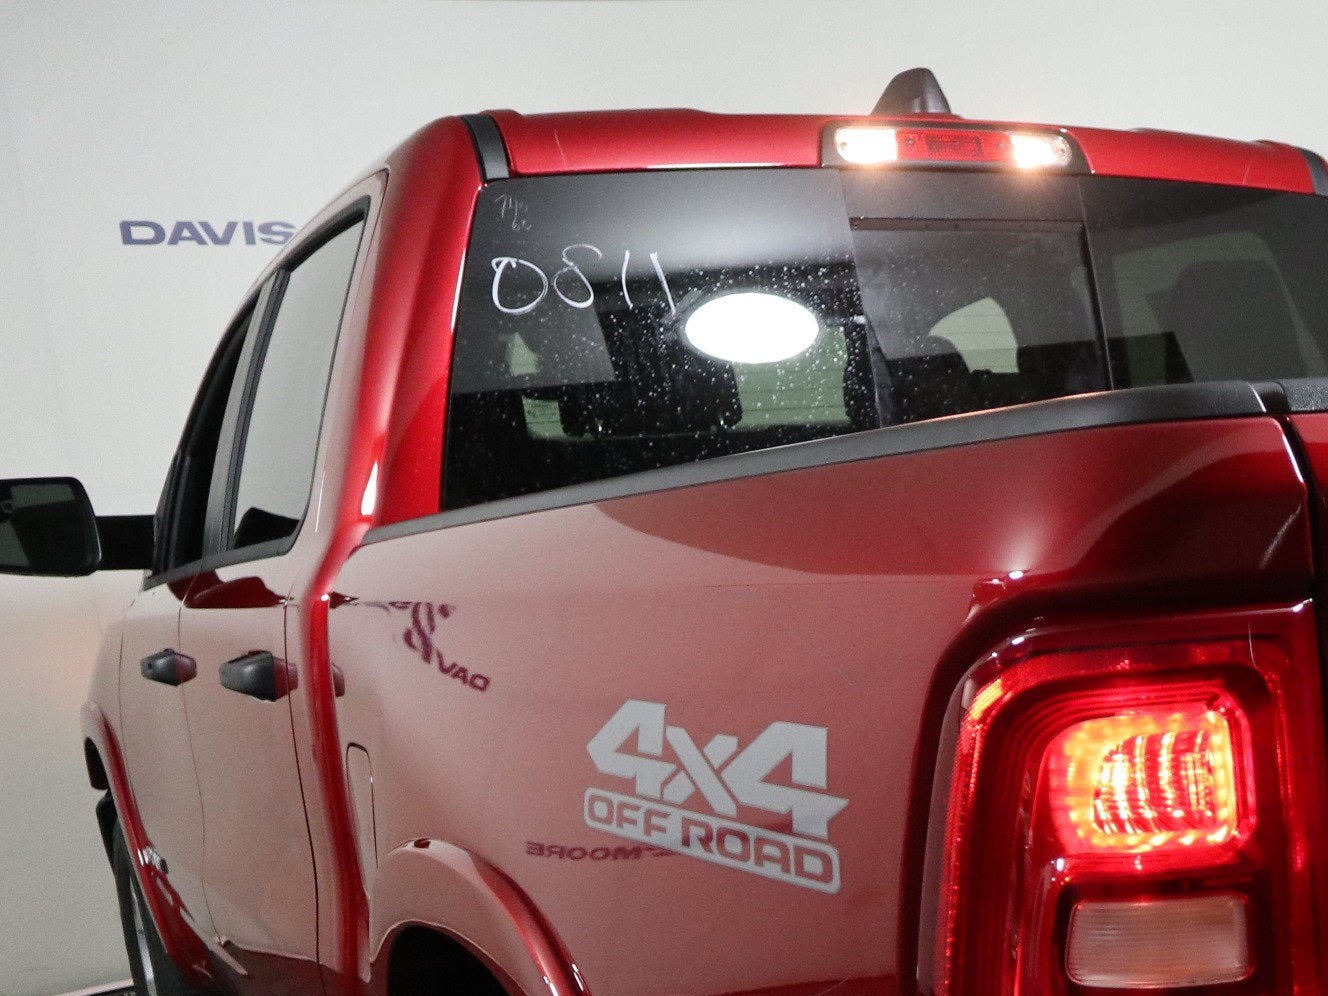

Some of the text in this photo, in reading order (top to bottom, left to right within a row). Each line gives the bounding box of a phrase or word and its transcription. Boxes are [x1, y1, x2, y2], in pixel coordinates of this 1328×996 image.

[119, 220, 297, 246] DAVIS
[491, 243, 676, 316] 0811
[587, 796, 834, 883] OFF ROAD
